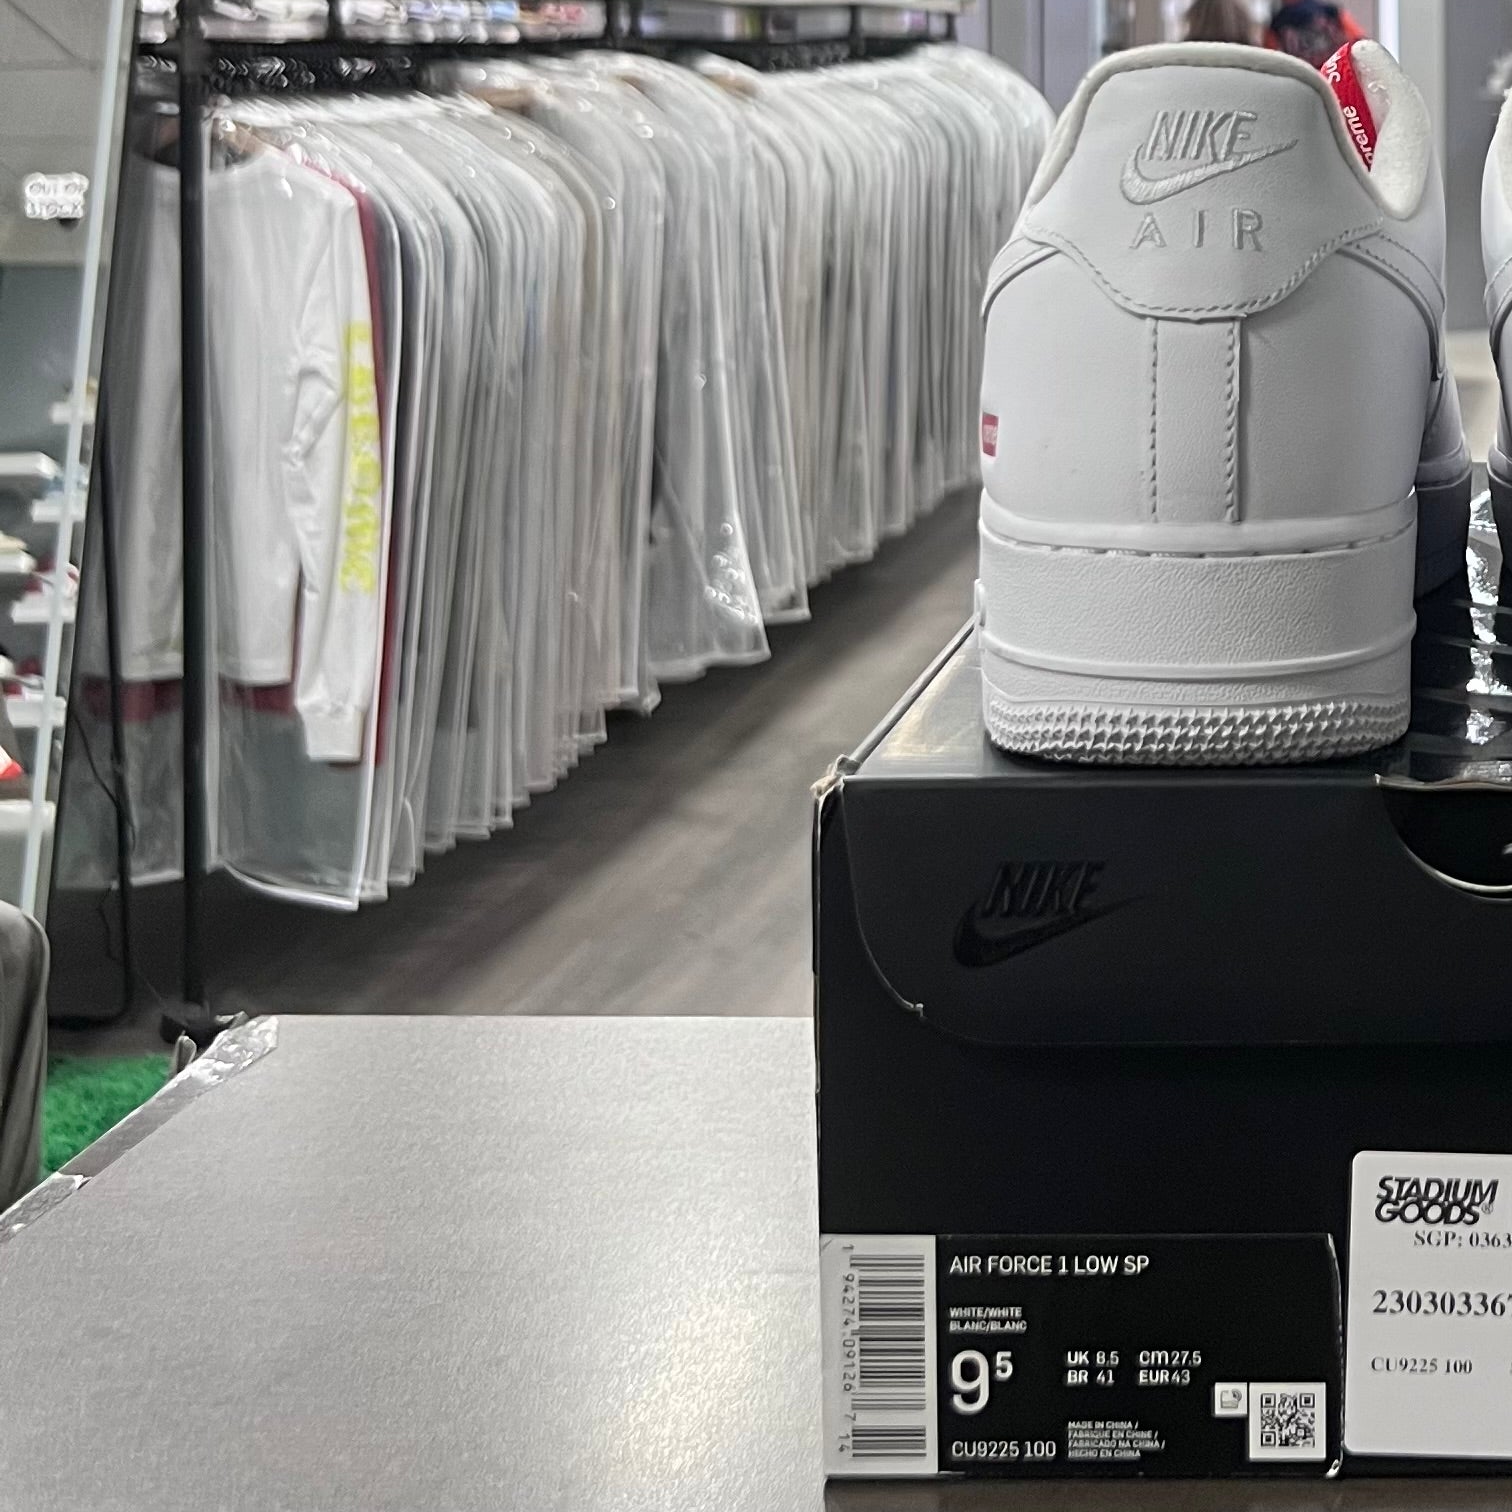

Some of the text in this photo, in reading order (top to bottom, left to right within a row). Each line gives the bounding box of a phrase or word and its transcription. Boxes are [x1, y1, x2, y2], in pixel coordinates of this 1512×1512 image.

[1144, 110, 1258, 162] NIKE
[1128, 207, 1263, 252] AIR
[977, 860, 1106, 919] NIKE
[1377, 1175, 1499, 1205] STADIUM
[1413, 1230, 1463, 1248] SGP:
[950, 1255, 1150, 1275] AIR FORCE 1 LOW SP
[949, 1307, 1022, 1318] WHITE/WHITE
[949, 1321, 1027, 1332] BLANC/BLANC
[1067, 1351, 1090, 1365] UK
[1096, 1351, 1120, 1366] 8.5
[1171, 1351, 1202, 1366] 27.5
[1371, 1357, 1473, 1374] CU9225 100
[1067, 1370, 1191, 1383] BR 41 EUR 43
[952, 1441, 1057, 1458] CU9225 100
